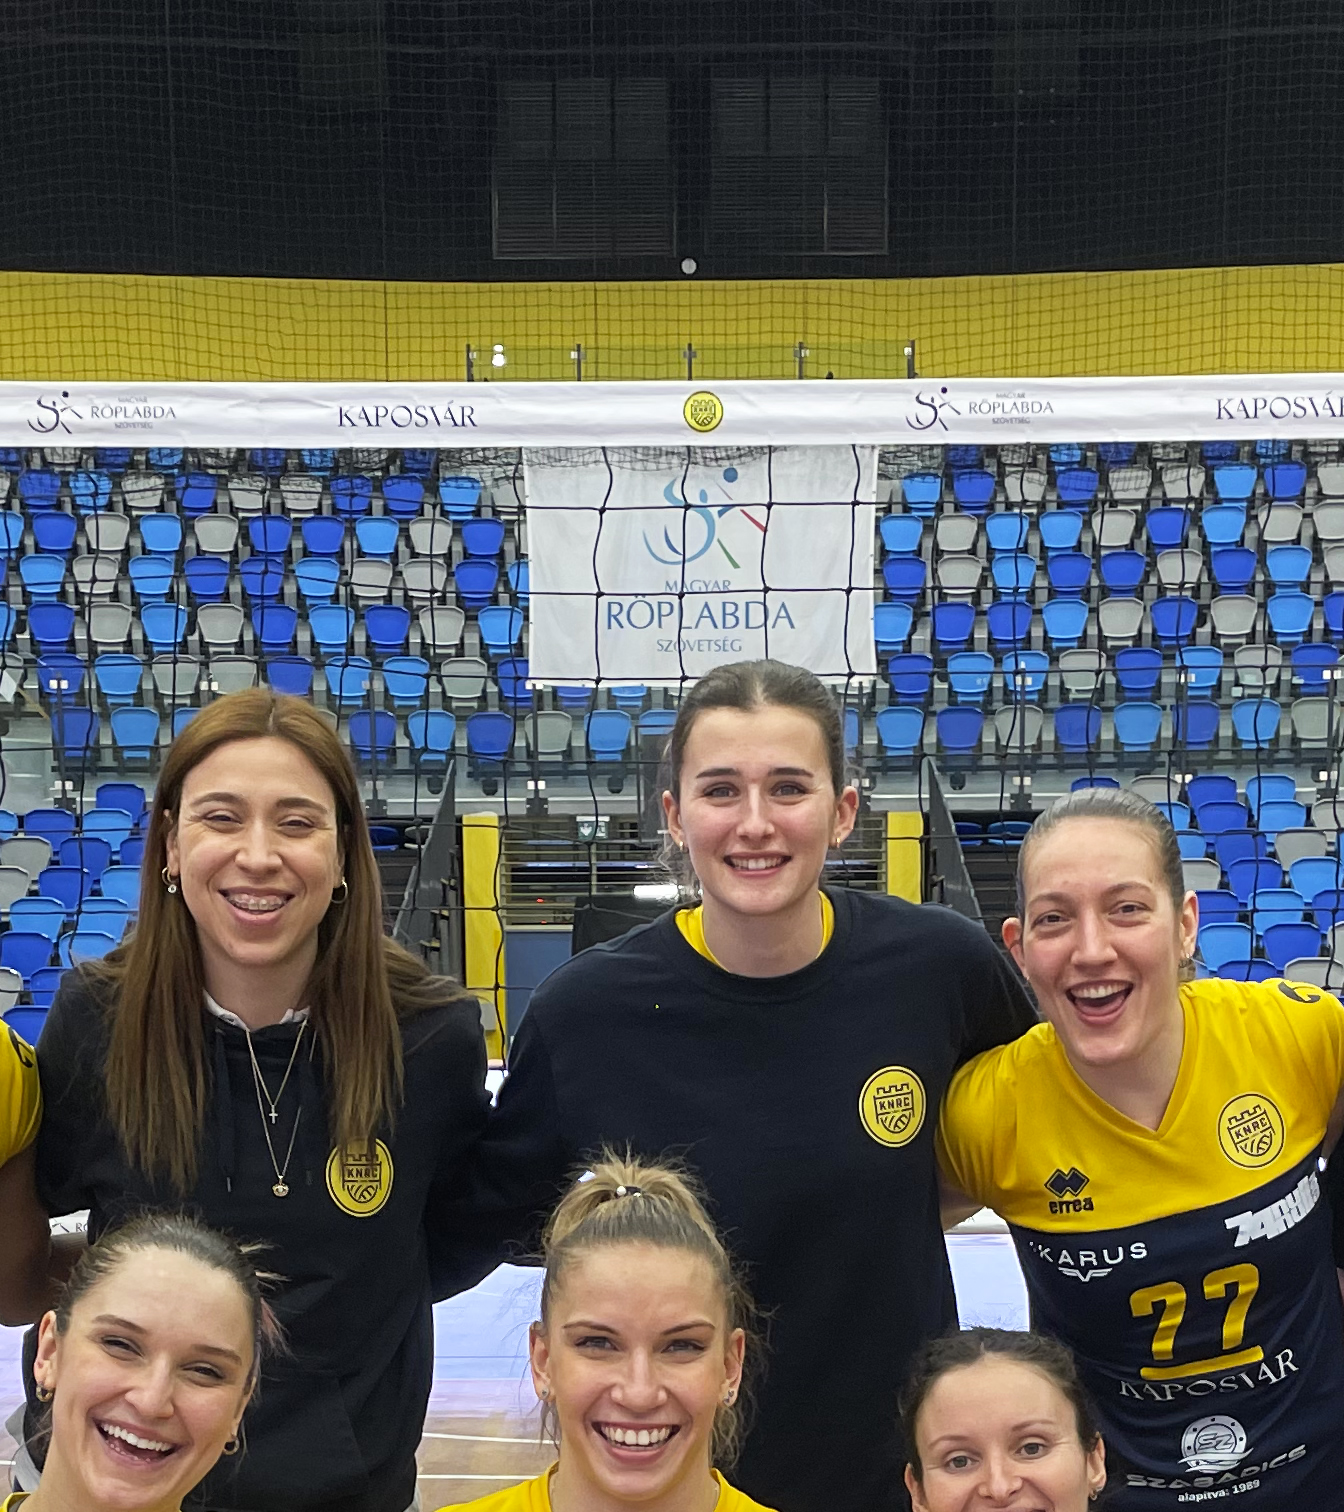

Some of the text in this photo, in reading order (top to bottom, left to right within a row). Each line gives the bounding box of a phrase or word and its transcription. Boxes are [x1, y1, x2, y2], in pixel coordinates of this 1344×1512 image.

[90, 402, 177, 420] RÖPLABDA
[338, 400, 478, 428] KAPOSVÁR
[968, 397, 1055, 415] RÖPLABDA
[664, 578, 732, 593] MAGYAR
[606, 595, 797, 631] RÖPLABDA
[655, 636, 744, 653] SZÖVETSÉG
[878, 1096, 910, 1111] KNRC
[1235, 1116, 1269, 1140] KNRC
[1125, 1443, 1306, 1489] SZABADICS
